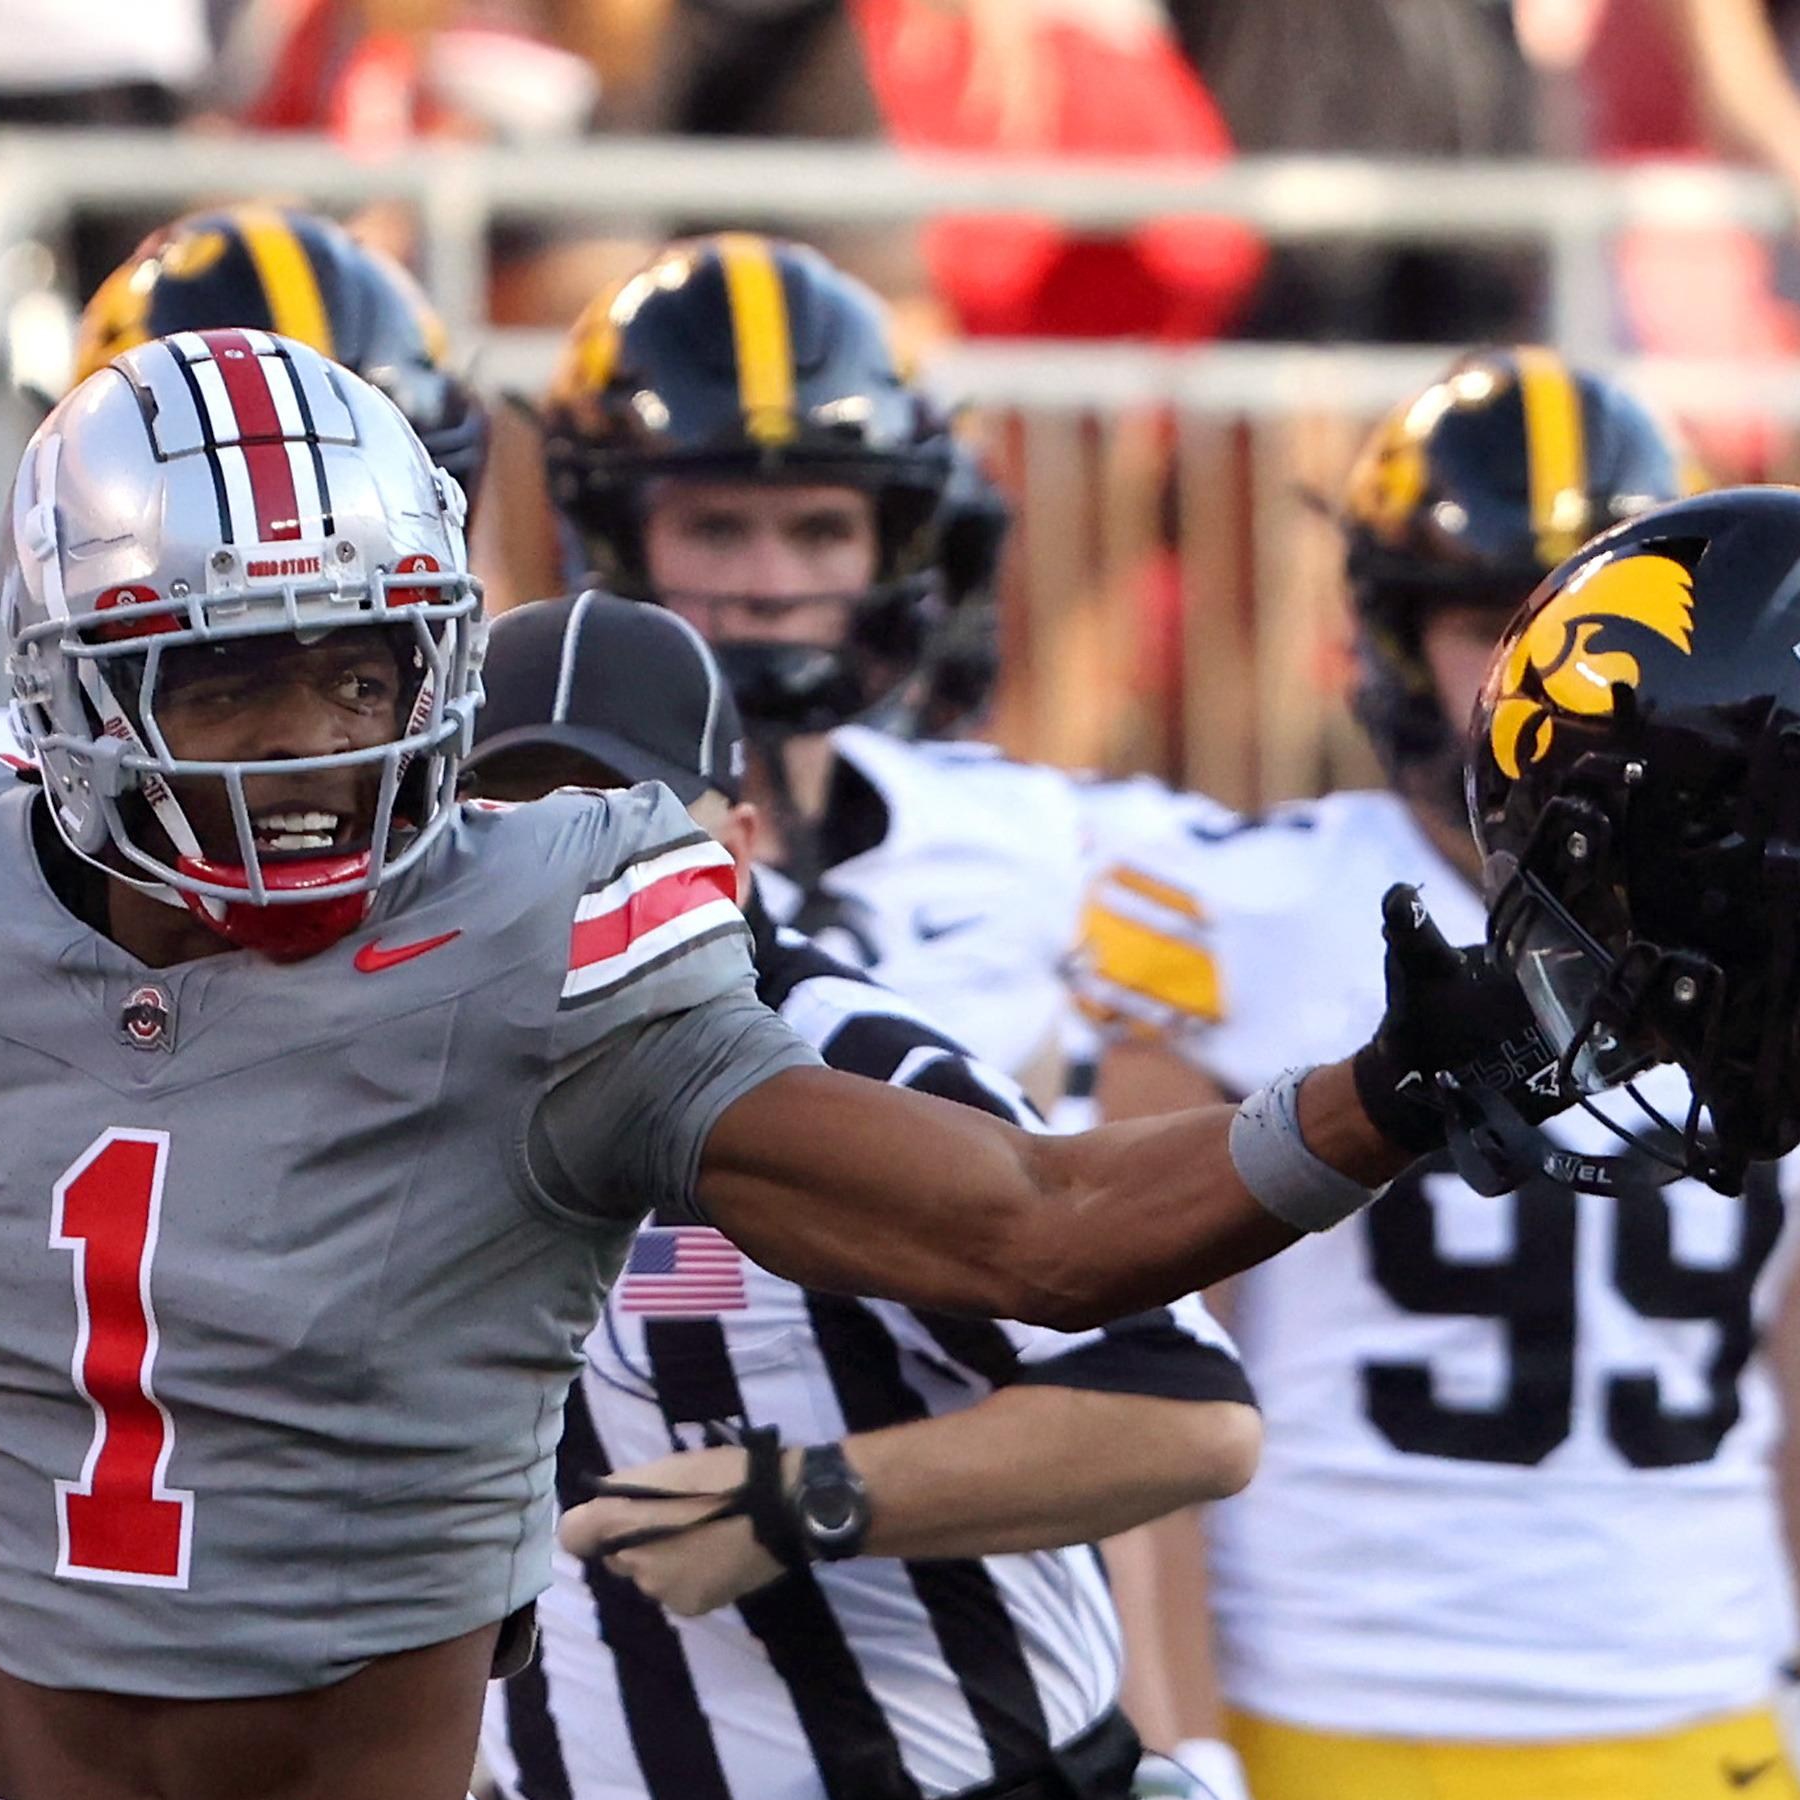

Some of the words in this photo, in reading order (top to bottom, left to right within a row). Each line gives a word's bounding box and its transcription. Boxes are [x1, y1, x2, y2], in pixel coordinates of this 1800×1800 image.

[281, 556, 321, 575] STATE
[48, 1126, 195, 1590] 1
[1360, 1138, 1785, 1468] 99
